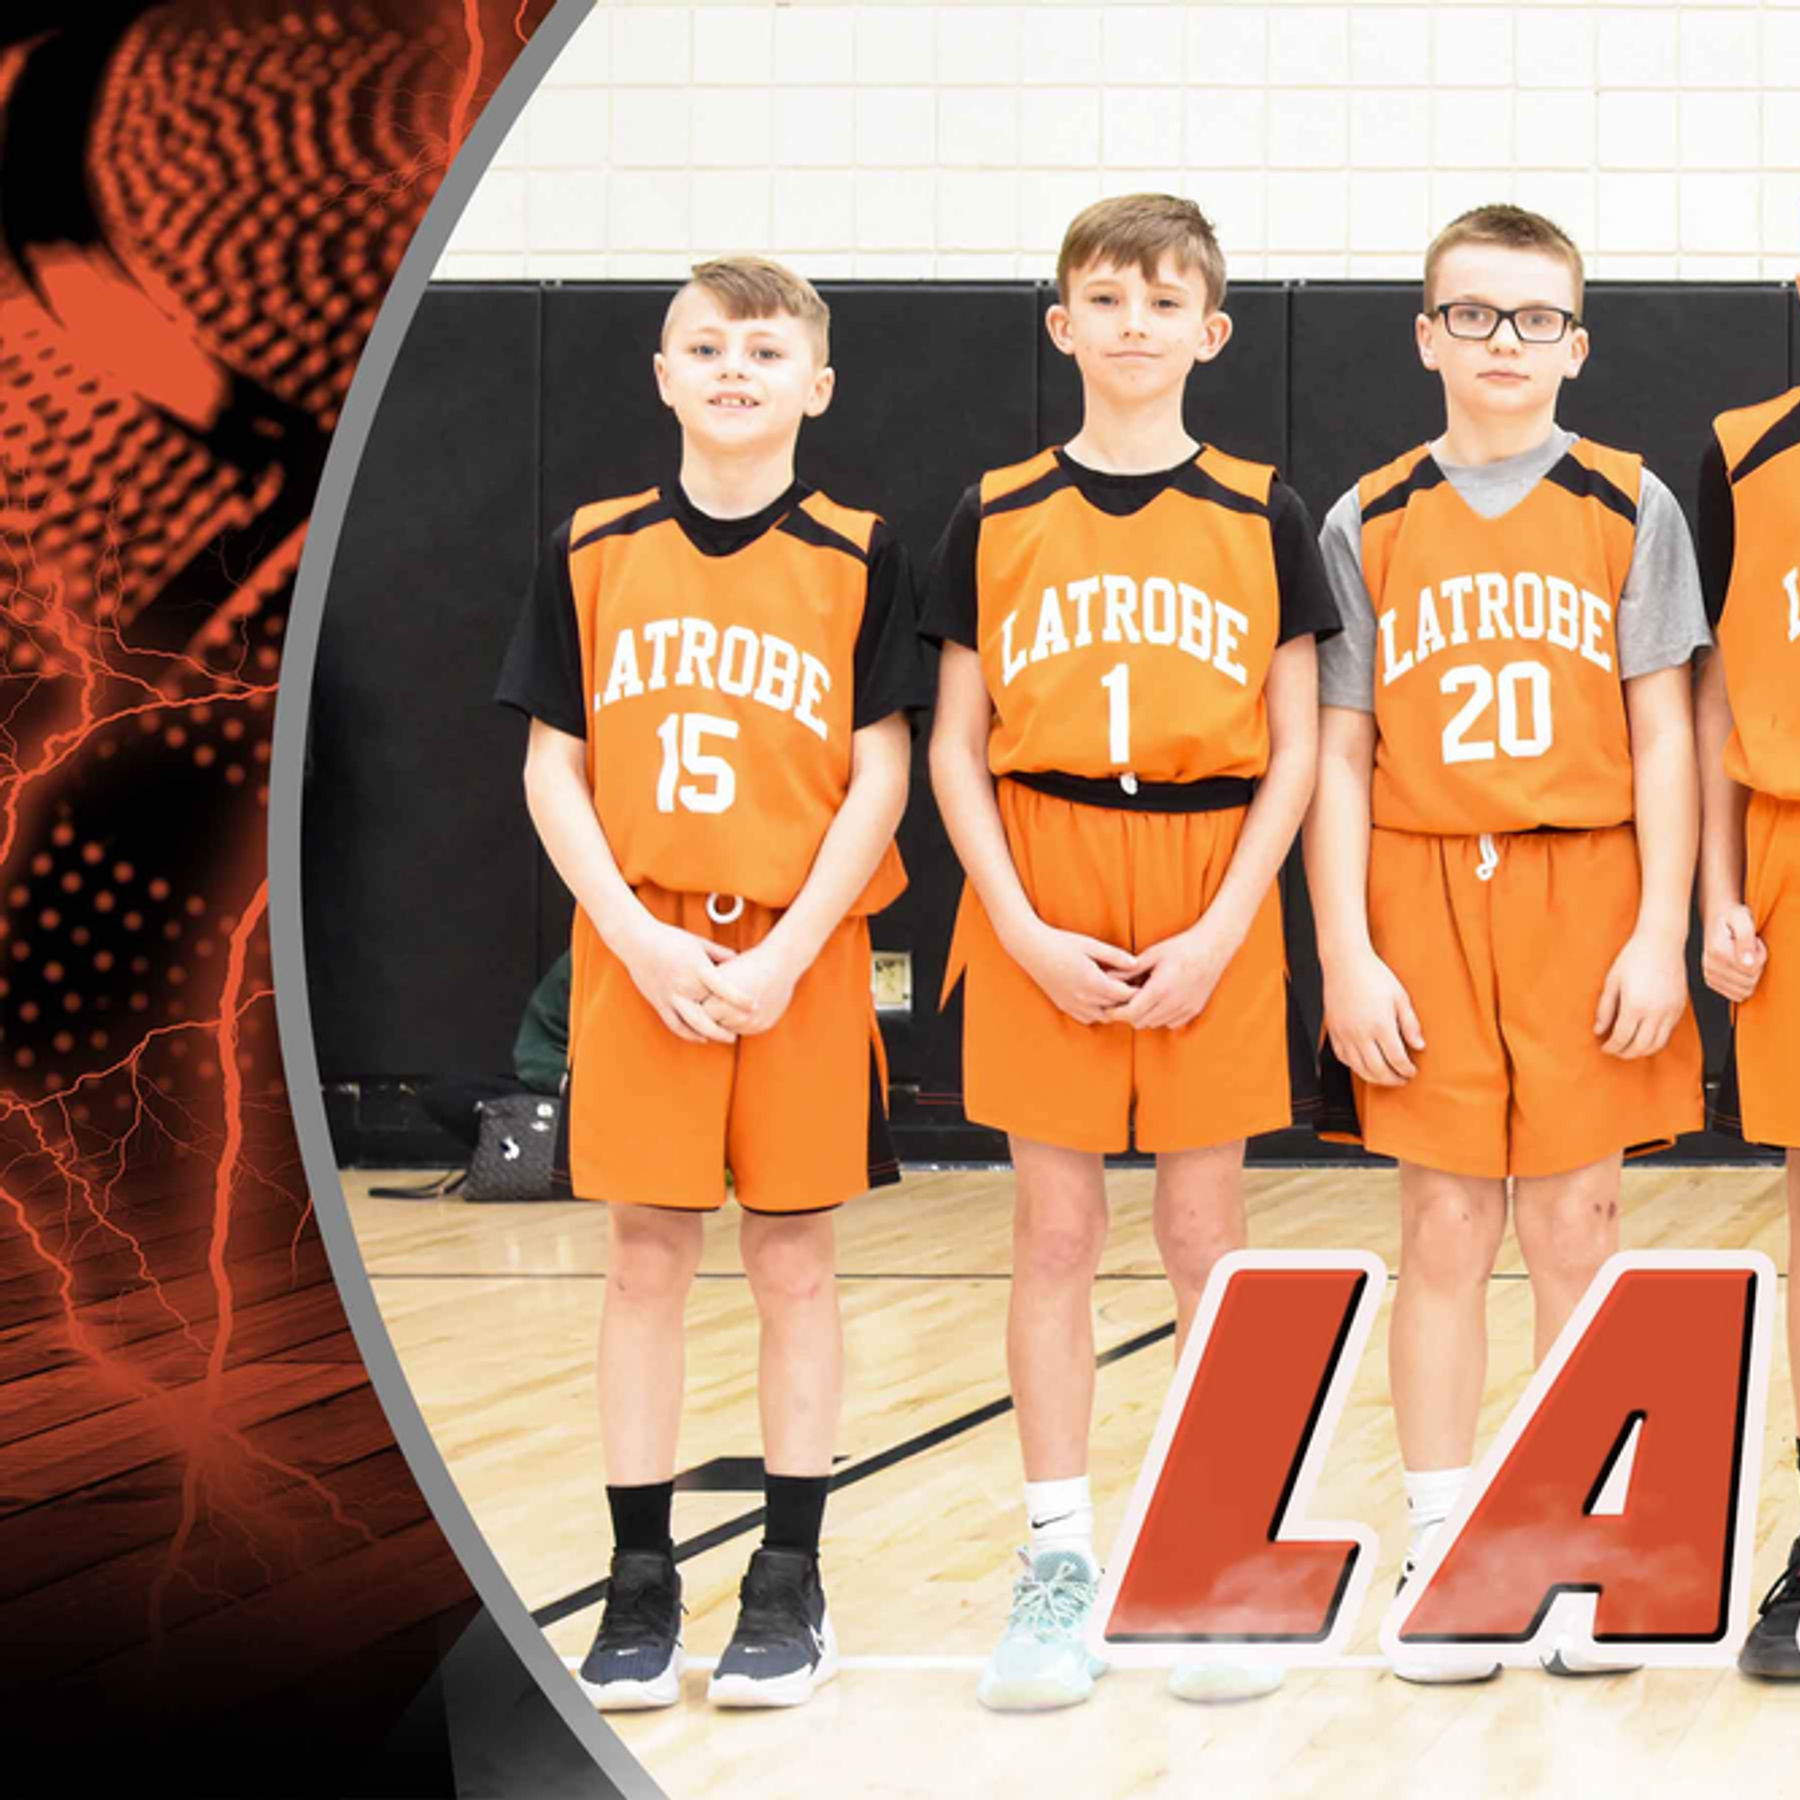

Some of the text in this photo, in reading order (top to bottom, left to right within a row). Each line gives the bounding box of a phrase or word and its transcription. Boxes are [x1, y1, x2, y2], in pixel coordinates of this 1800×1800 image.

[593, 616, 832, 742] ATROBE
[1002, 574, 1250, 687] LATROBE
[1379, 571, 1613, 687] LATROBE
[655, 712, 741, 815] 15
[1099, 662, 1131, 765] 1
[1439, 660, 1554, 765] 20
